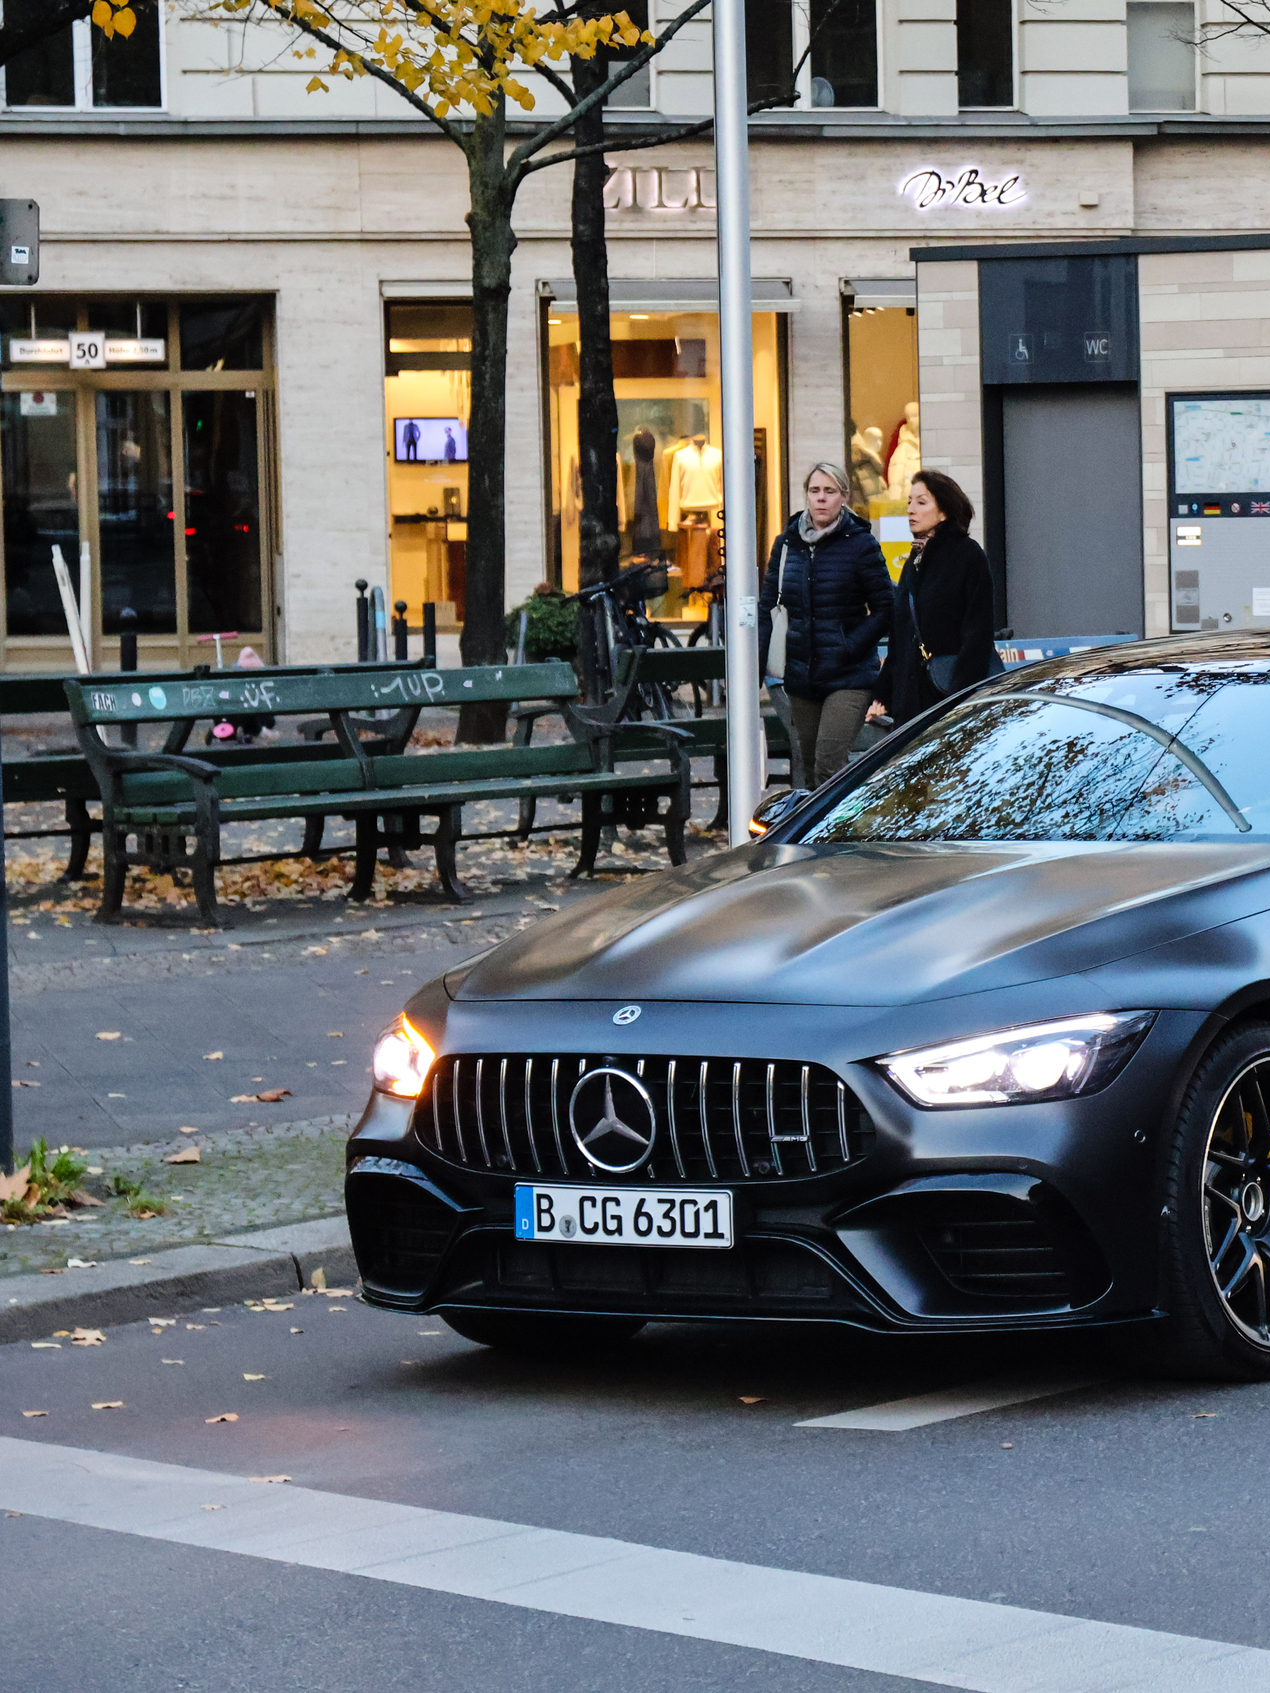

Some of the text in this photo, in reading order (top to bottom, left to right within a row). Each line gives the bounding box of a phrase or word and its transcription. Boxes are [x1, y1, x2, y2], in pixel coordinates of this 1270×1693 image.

[76, 342, 99, 359] 50
[1085, 338, 1109, 355] WC
[536, 1193, 725, 1240] B CG 6301
